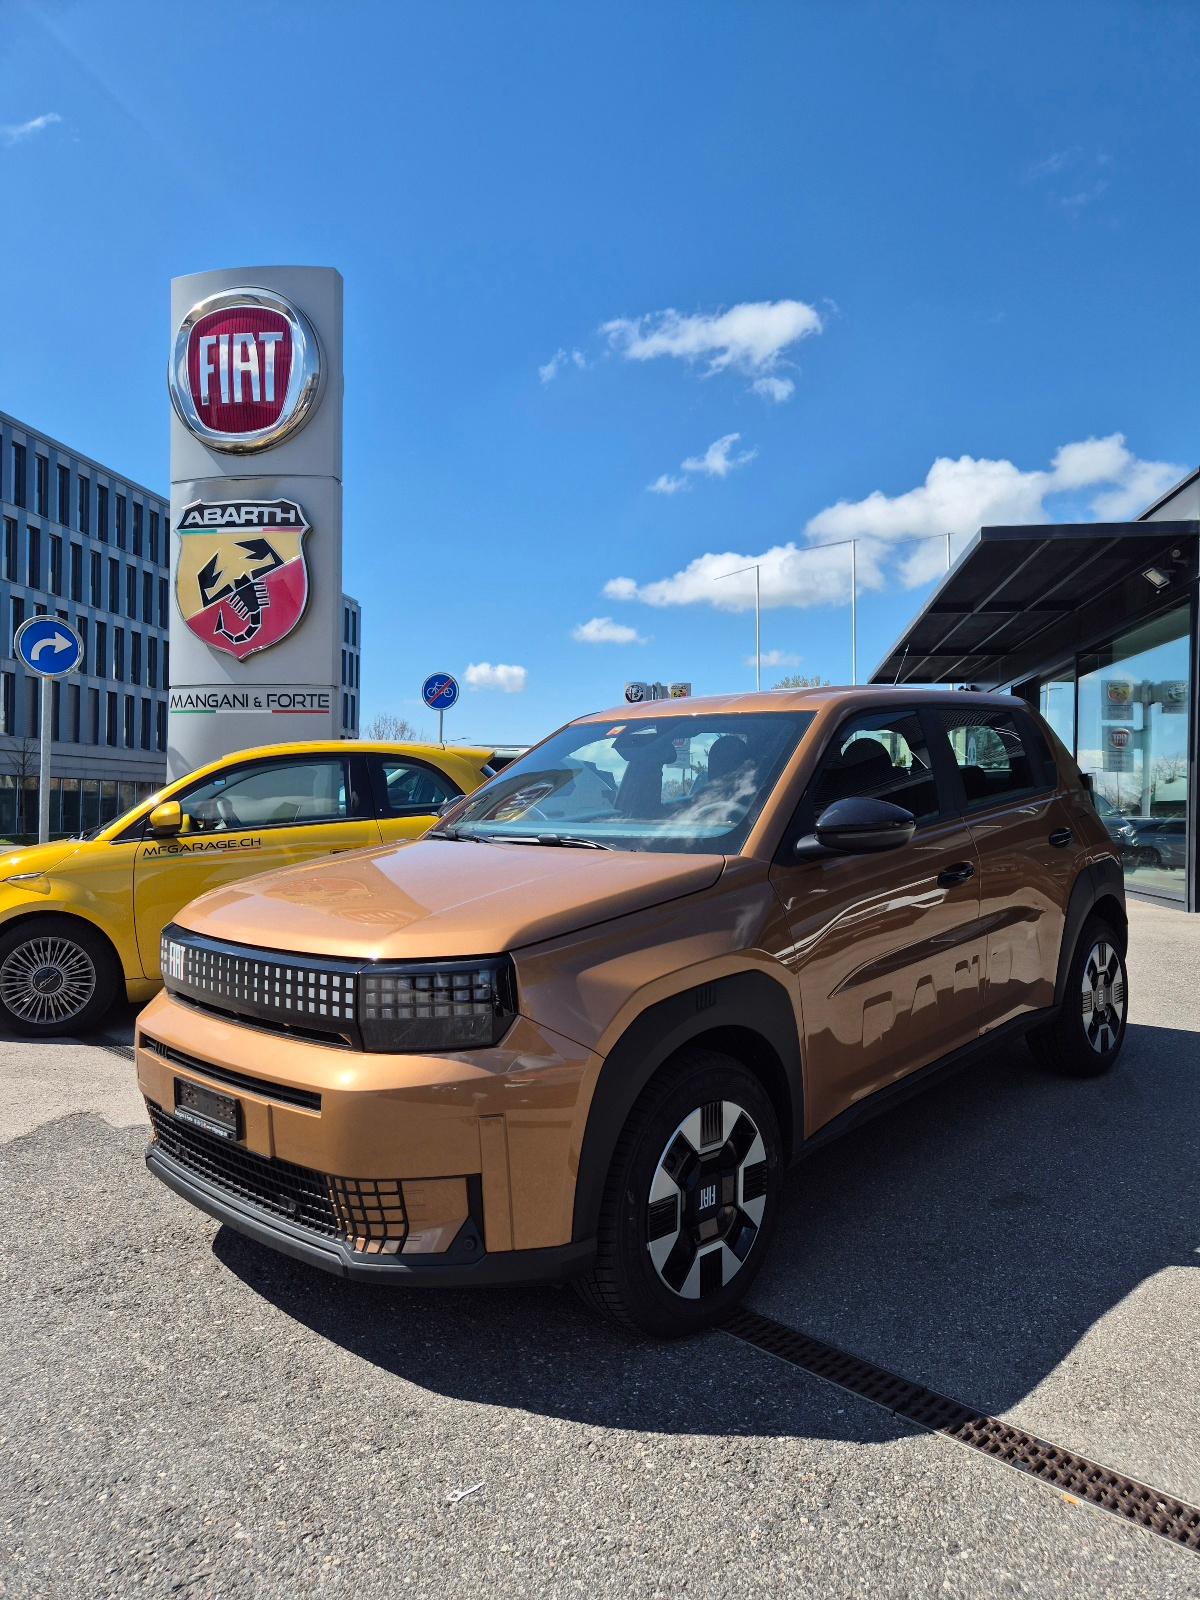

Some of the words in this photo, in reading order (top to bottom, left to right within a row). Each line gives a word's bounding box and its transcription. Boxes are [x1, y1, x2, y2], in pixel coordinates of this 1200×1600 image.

[200, 332, 283, 406] FIAT
[184, 507, 296, 525] ABARTH
[170, 694, 249, 708] MANGANI
[253, 696, 262, 708] &
[266, 694, 330, 708] FORTE
[143, 838, 261, 856] MFGARAGE.CH
[169, 941, 186, 981] FIAT
[699, 1184, 716, 1210] FIAT
